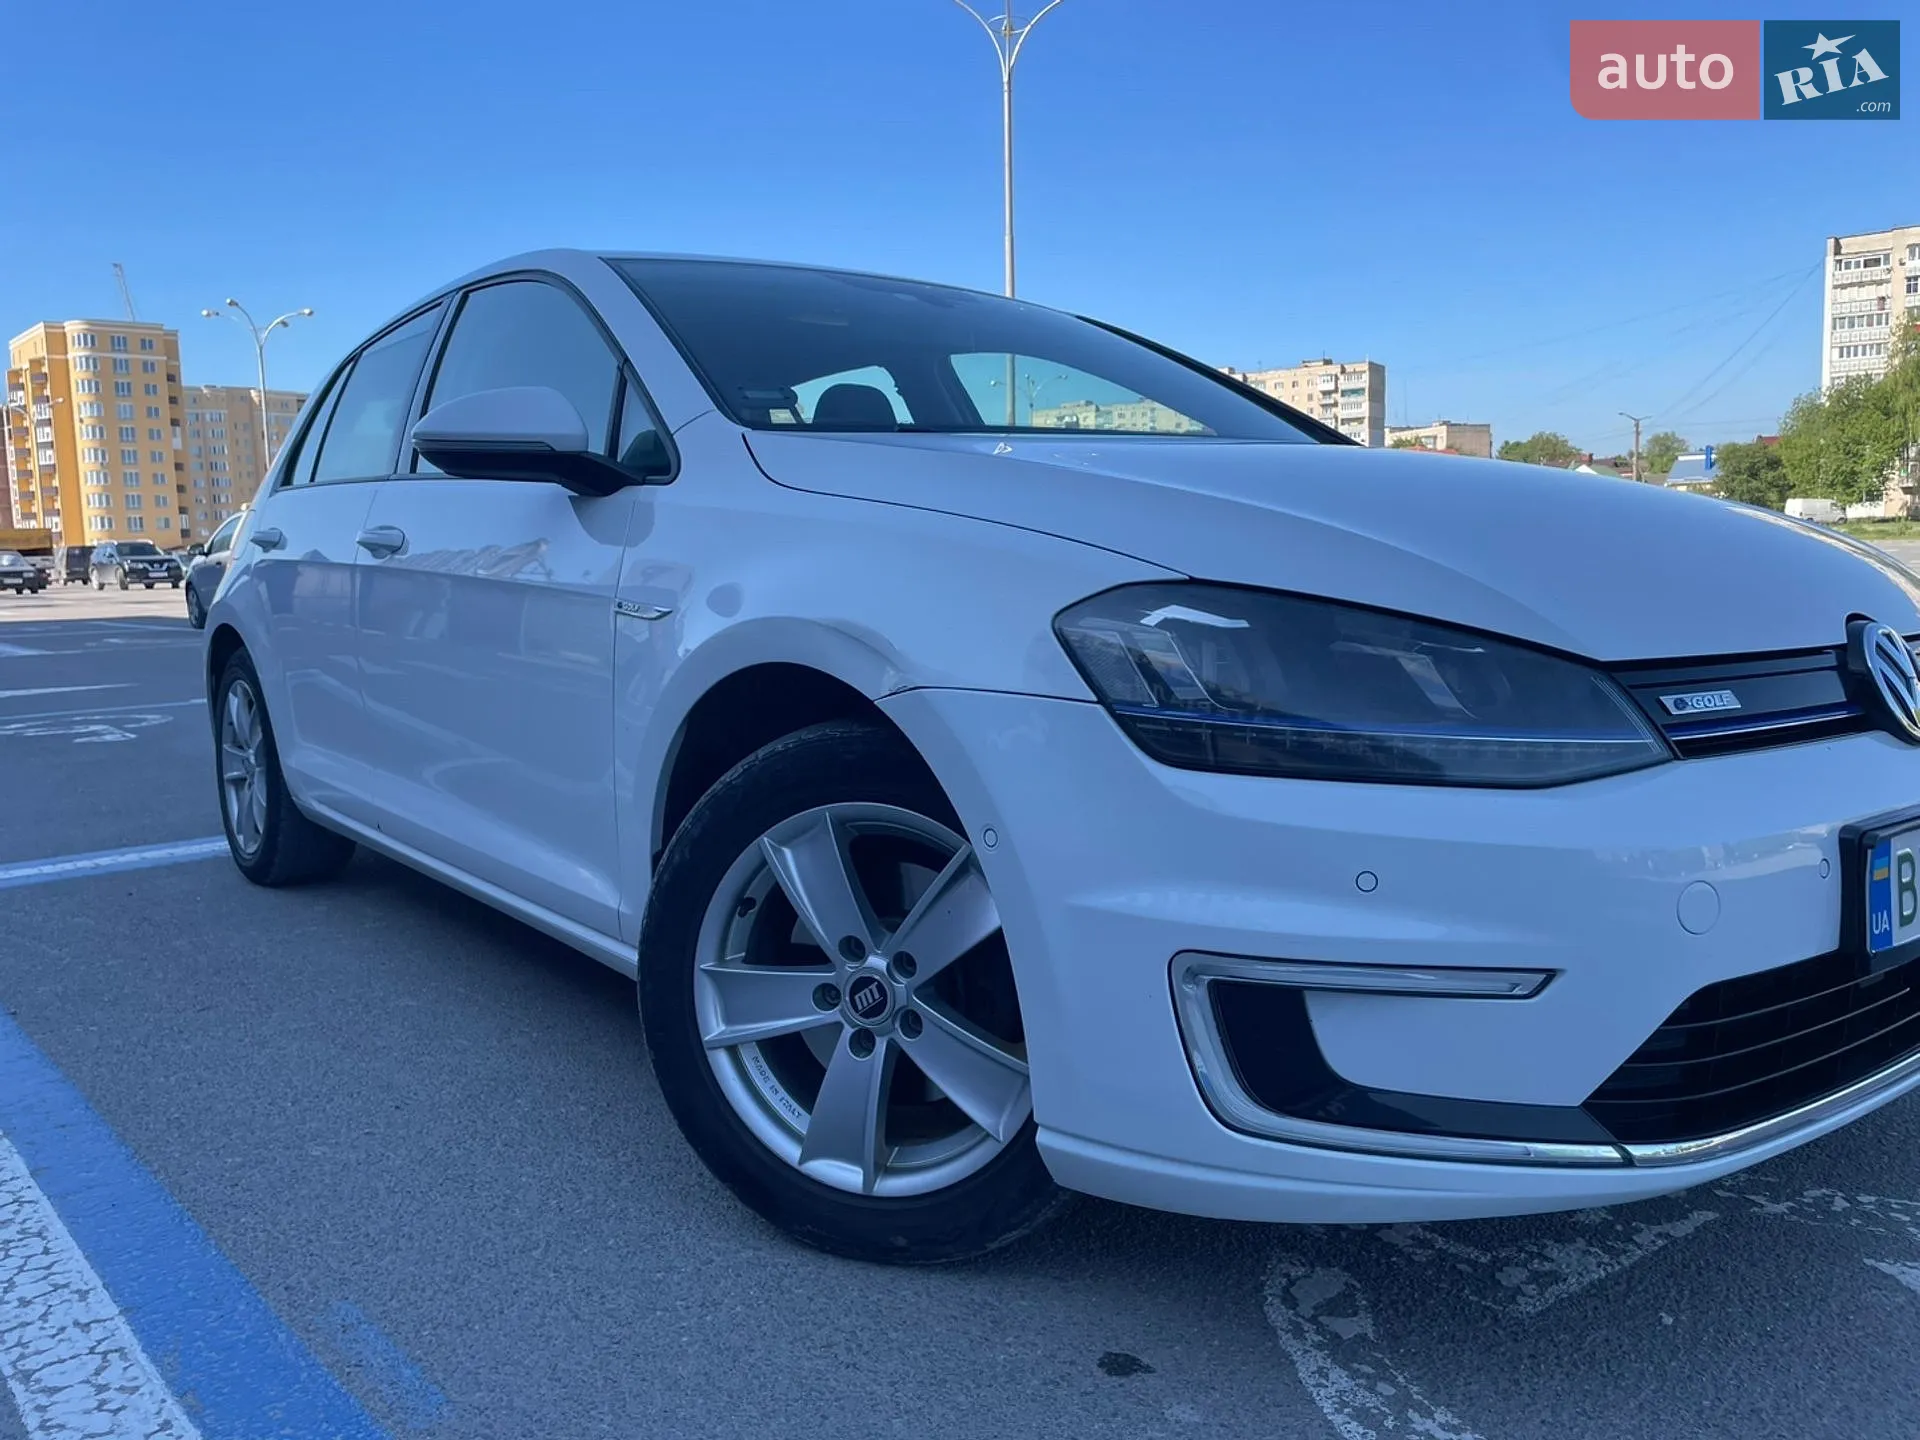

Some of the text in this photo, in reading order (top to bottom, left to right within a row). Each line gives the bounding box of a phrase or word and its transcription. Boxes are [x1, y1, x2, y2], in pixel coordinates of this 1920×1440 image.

[1871, 910, 1890, 935] UA
[752, 1055, 803, 1119] MADE IN ITALY
